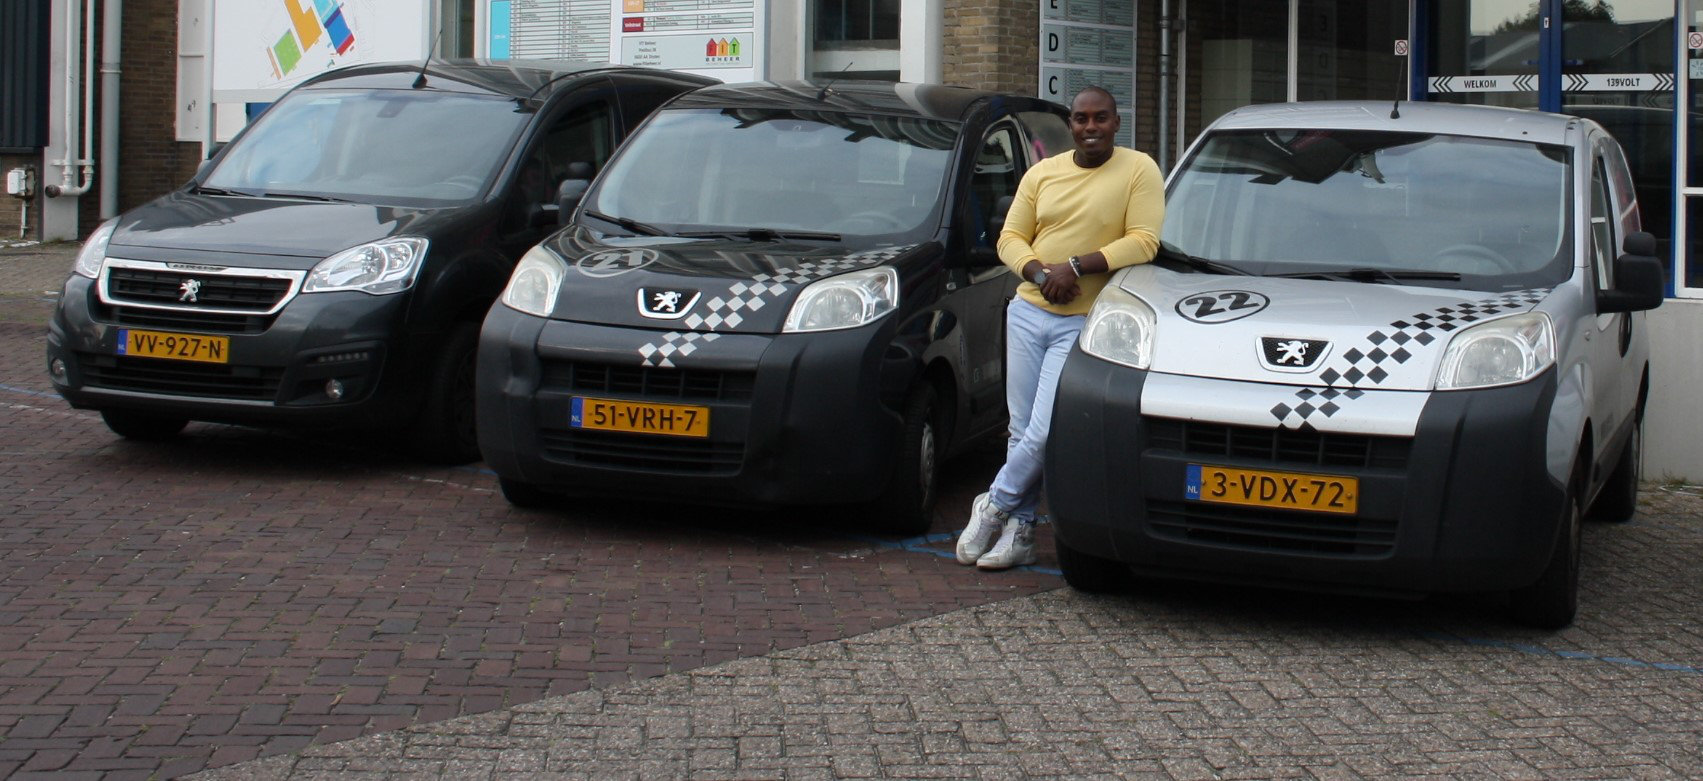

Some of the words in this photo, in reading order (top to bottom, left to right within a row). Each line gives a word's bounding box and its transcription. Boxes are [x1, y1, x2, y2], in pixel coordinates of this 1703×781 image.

[1048, 33, 1059, 52] D
[1048, 75, 1058, 95] C
[1463, 80, 1497, 88] WELKOM
[1606, 78, 1640, 87] 139VOLT
[591, 250, 644, 272] 21
[1185, 292, 1260, 318] 22
[134, 333, 221, 359] VV-927-N
[571, 414, 581, 423] NL
[594, 403, 698, 431] 51-VRH-7
[1187, 485, 1198, 494] NL
[1212, 472, 1344, 508] 3-VDX-72
